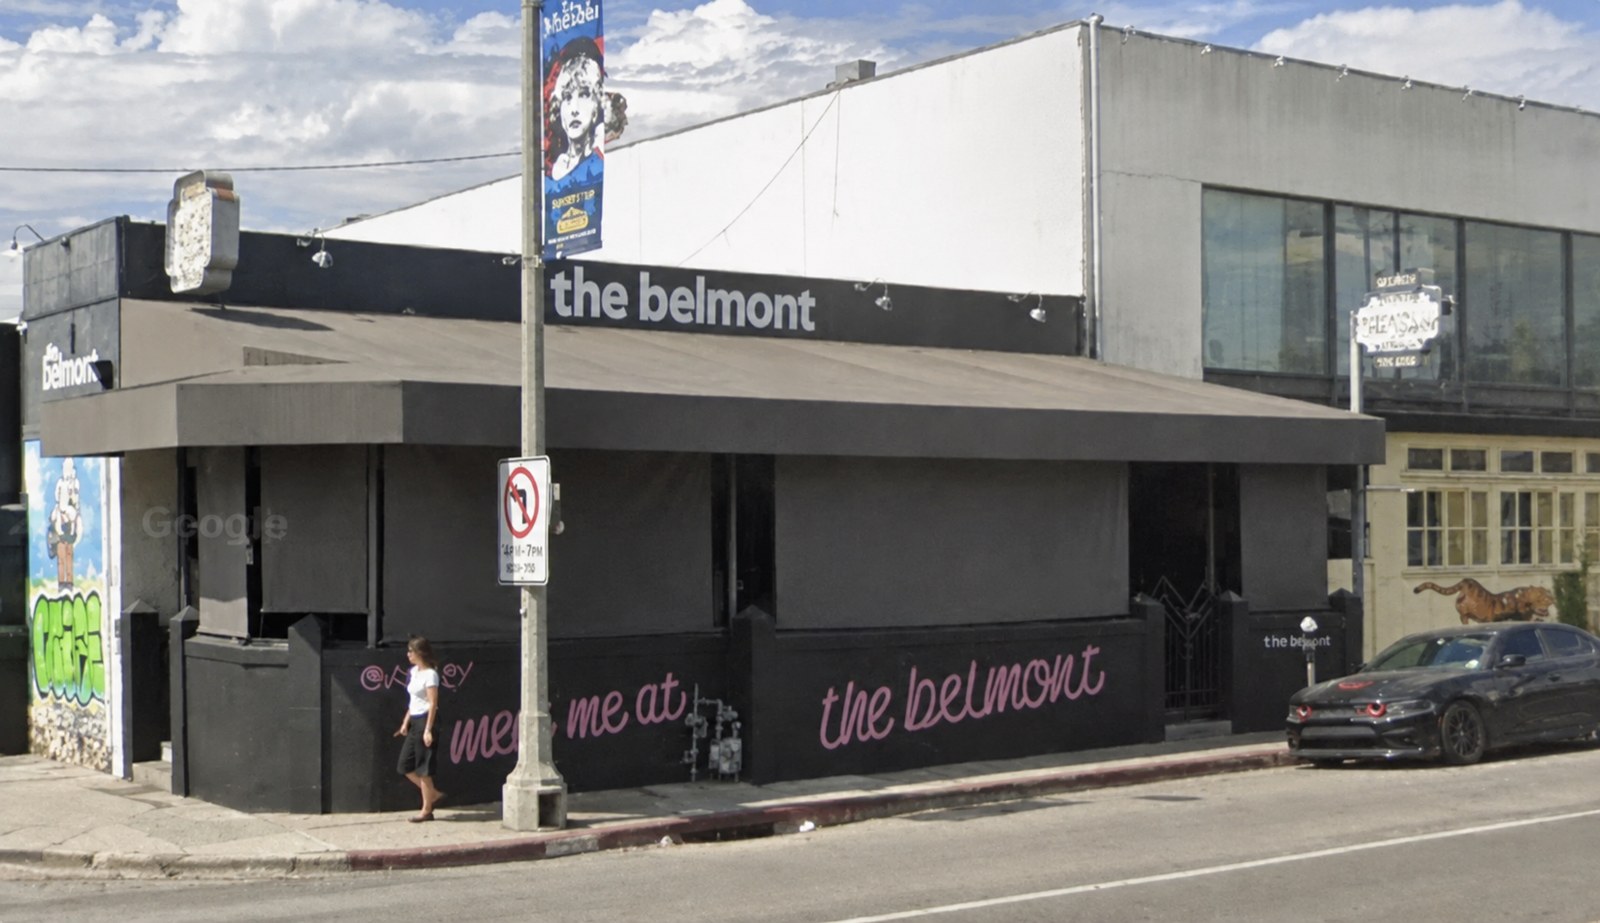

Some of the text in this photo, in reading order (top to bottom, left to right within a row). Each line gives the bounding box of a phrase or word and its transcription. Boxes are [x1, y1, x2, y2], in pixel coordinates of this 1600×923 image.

[550, 266, 816, 331] the belmont
[1264, 635, 1288, 648] the
[567, 691, 629, 739] me
[636, 672, 686, 725] at
[820, 645, 1105, 749] the belmont
